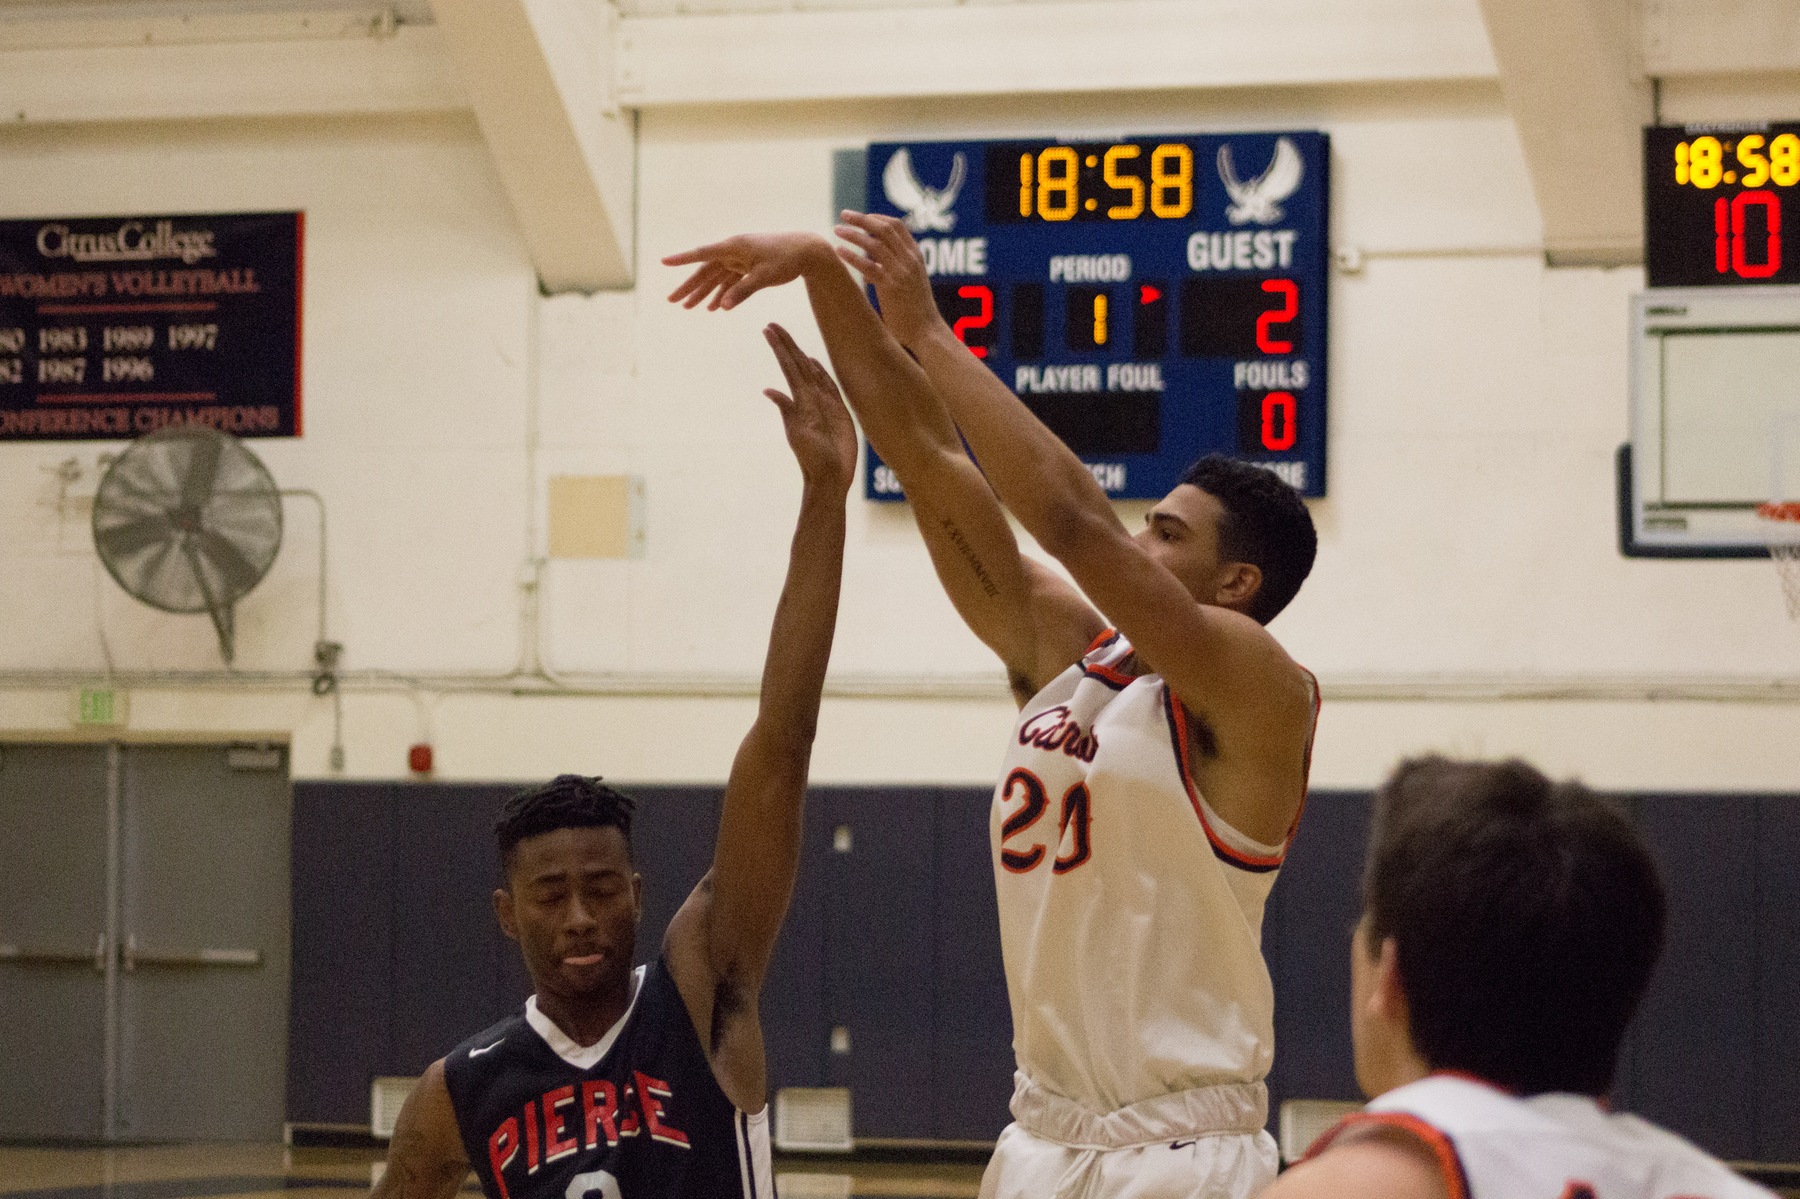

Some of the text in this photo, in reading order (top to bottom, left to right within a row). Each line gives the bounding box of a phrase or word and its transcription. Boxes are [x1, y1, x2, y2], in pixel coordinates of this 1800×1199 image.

[1019, 143, 1194, 221] 18:58
[917, 238, 988, 275] OME
[1187, 230, 1296, 271] GUEST
[1714, 190, 1782, 278] 10
[1049, 254, 1132, 283] PERIOD
[953, 285, 994, 358] 2
[1094, 294, 1108, 345] 1
[1255, 279, 1299, 354] 2
[1015, 363, 1165, 393] PLAYER FOUL
[1233, 360, 1310, 390] FOULS
[1261, 391, 1297, 450] 0
[1000, 767, 1093, 875] 20
